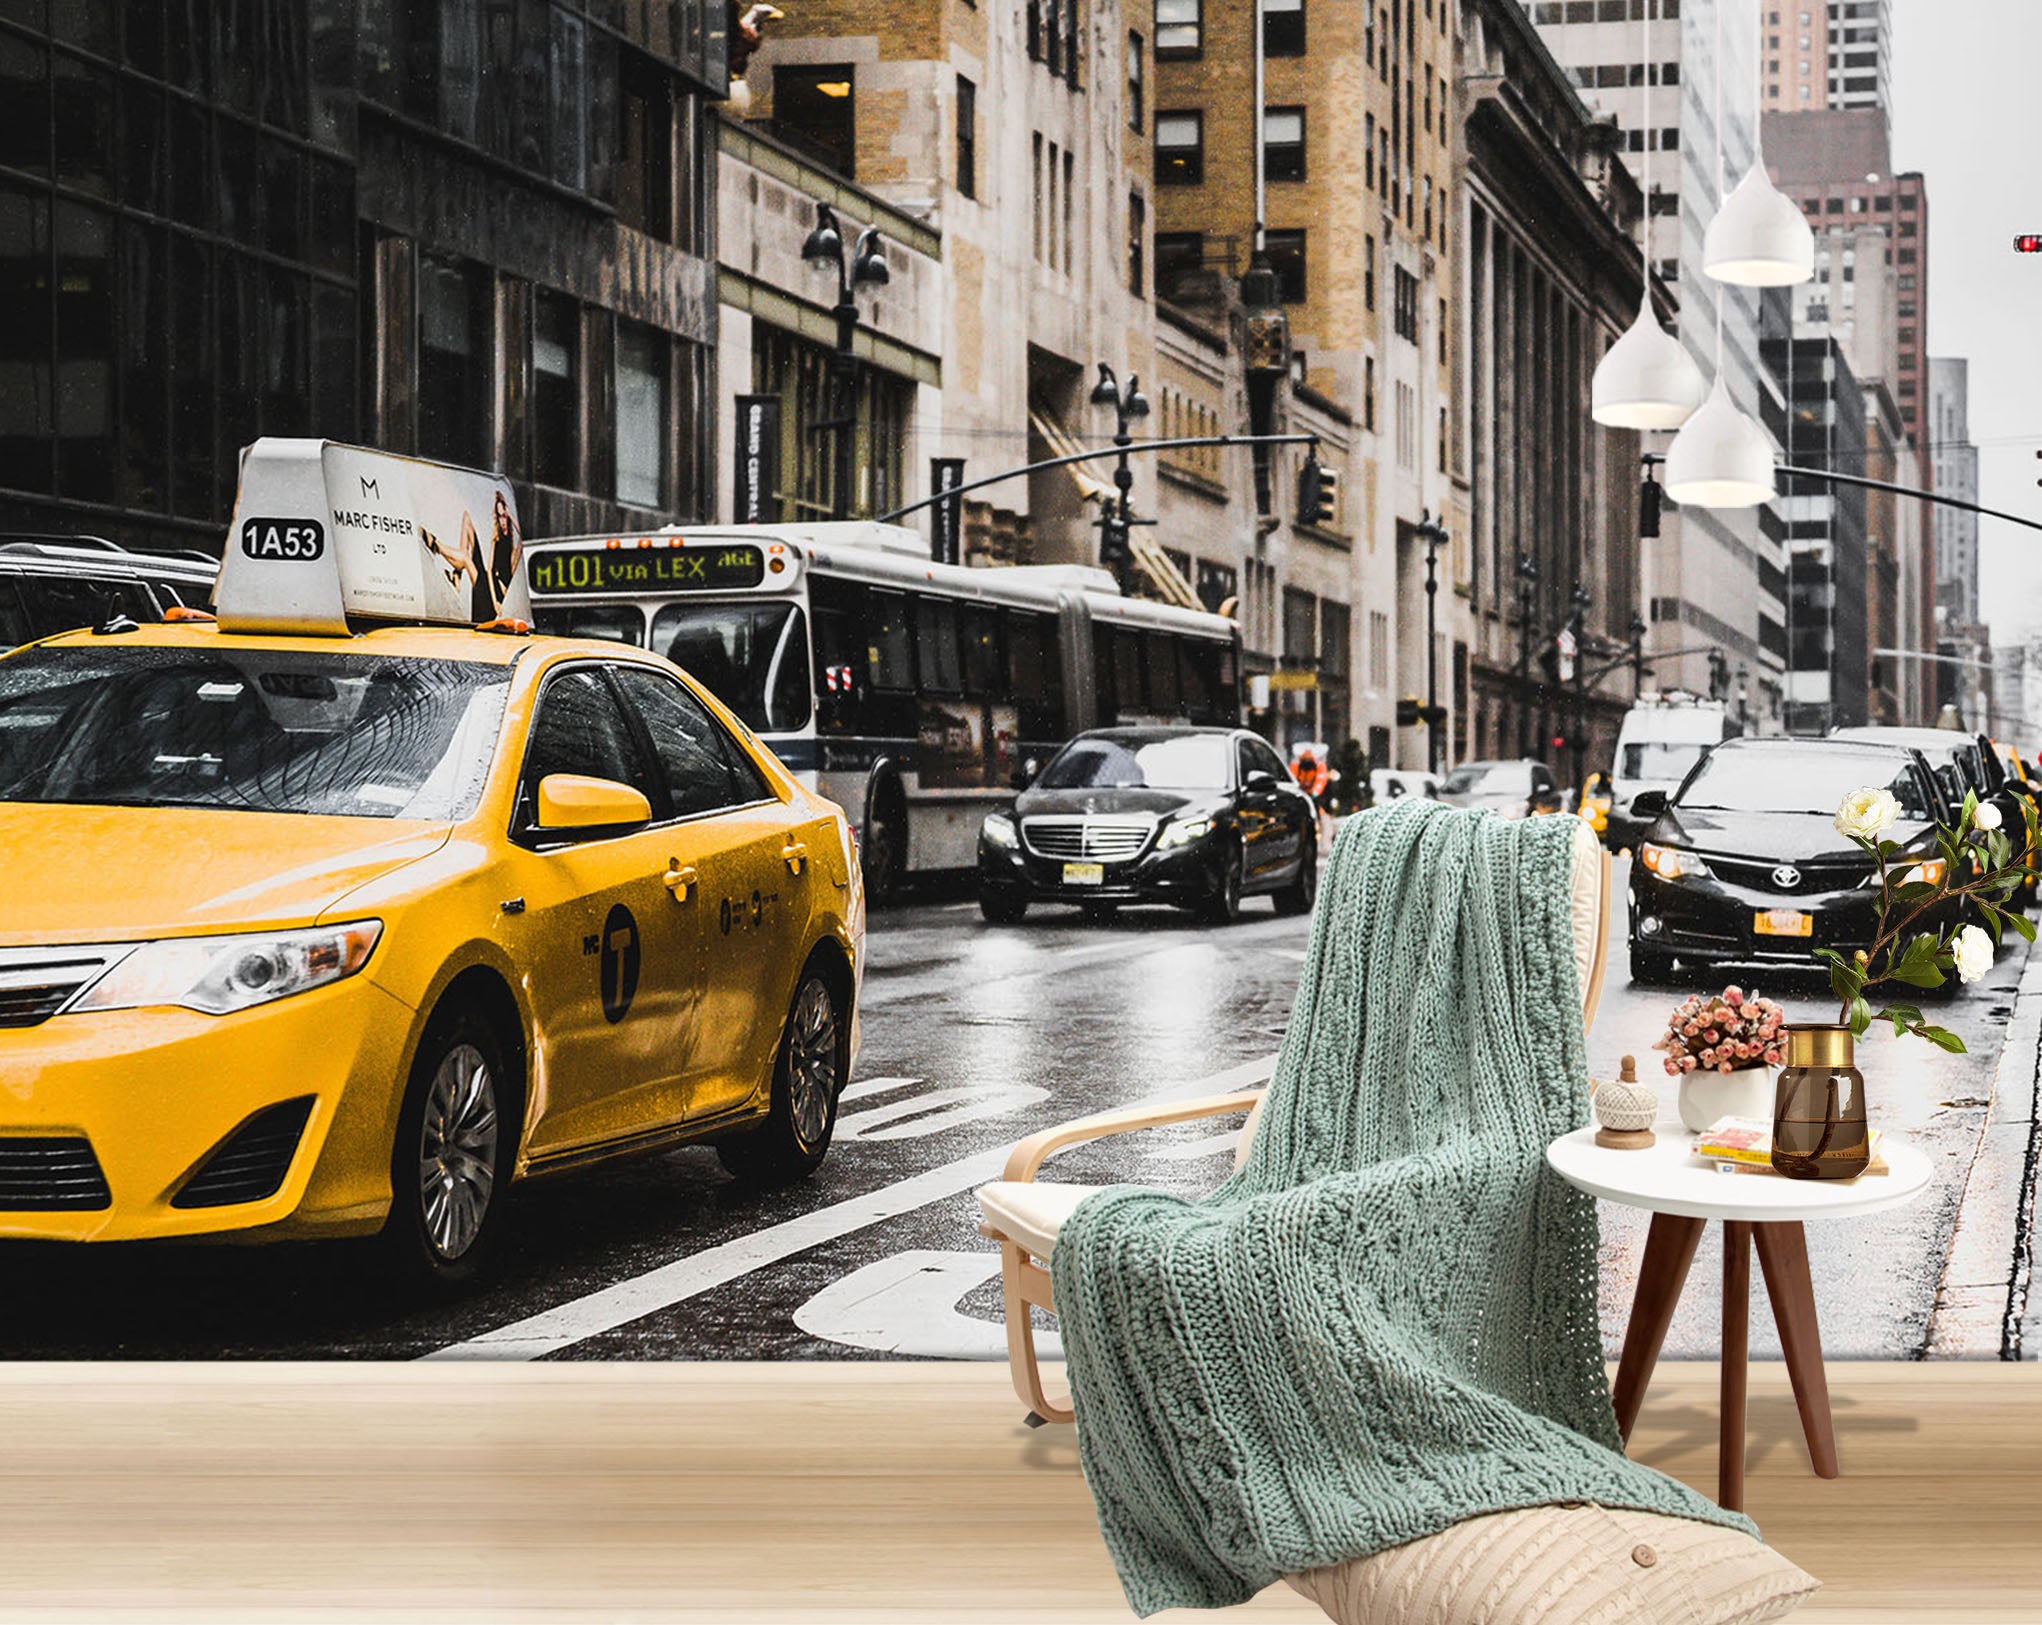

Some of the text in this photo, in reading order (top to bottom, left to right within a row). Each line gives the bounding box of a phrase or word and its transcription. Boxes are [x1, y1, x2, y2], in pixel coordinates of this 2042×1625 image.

[748, 404, 761, 519] GRAND CENTRAL
[360, 475, 380, 500] M
[333, 510, 413, 536] MARC FISHER
[245, 525, 317, 557] 1A53
[536, 555, 605, 588] M101
[609, 564, 649, 580] VIA
[656, 557, 705, 579] LEX
